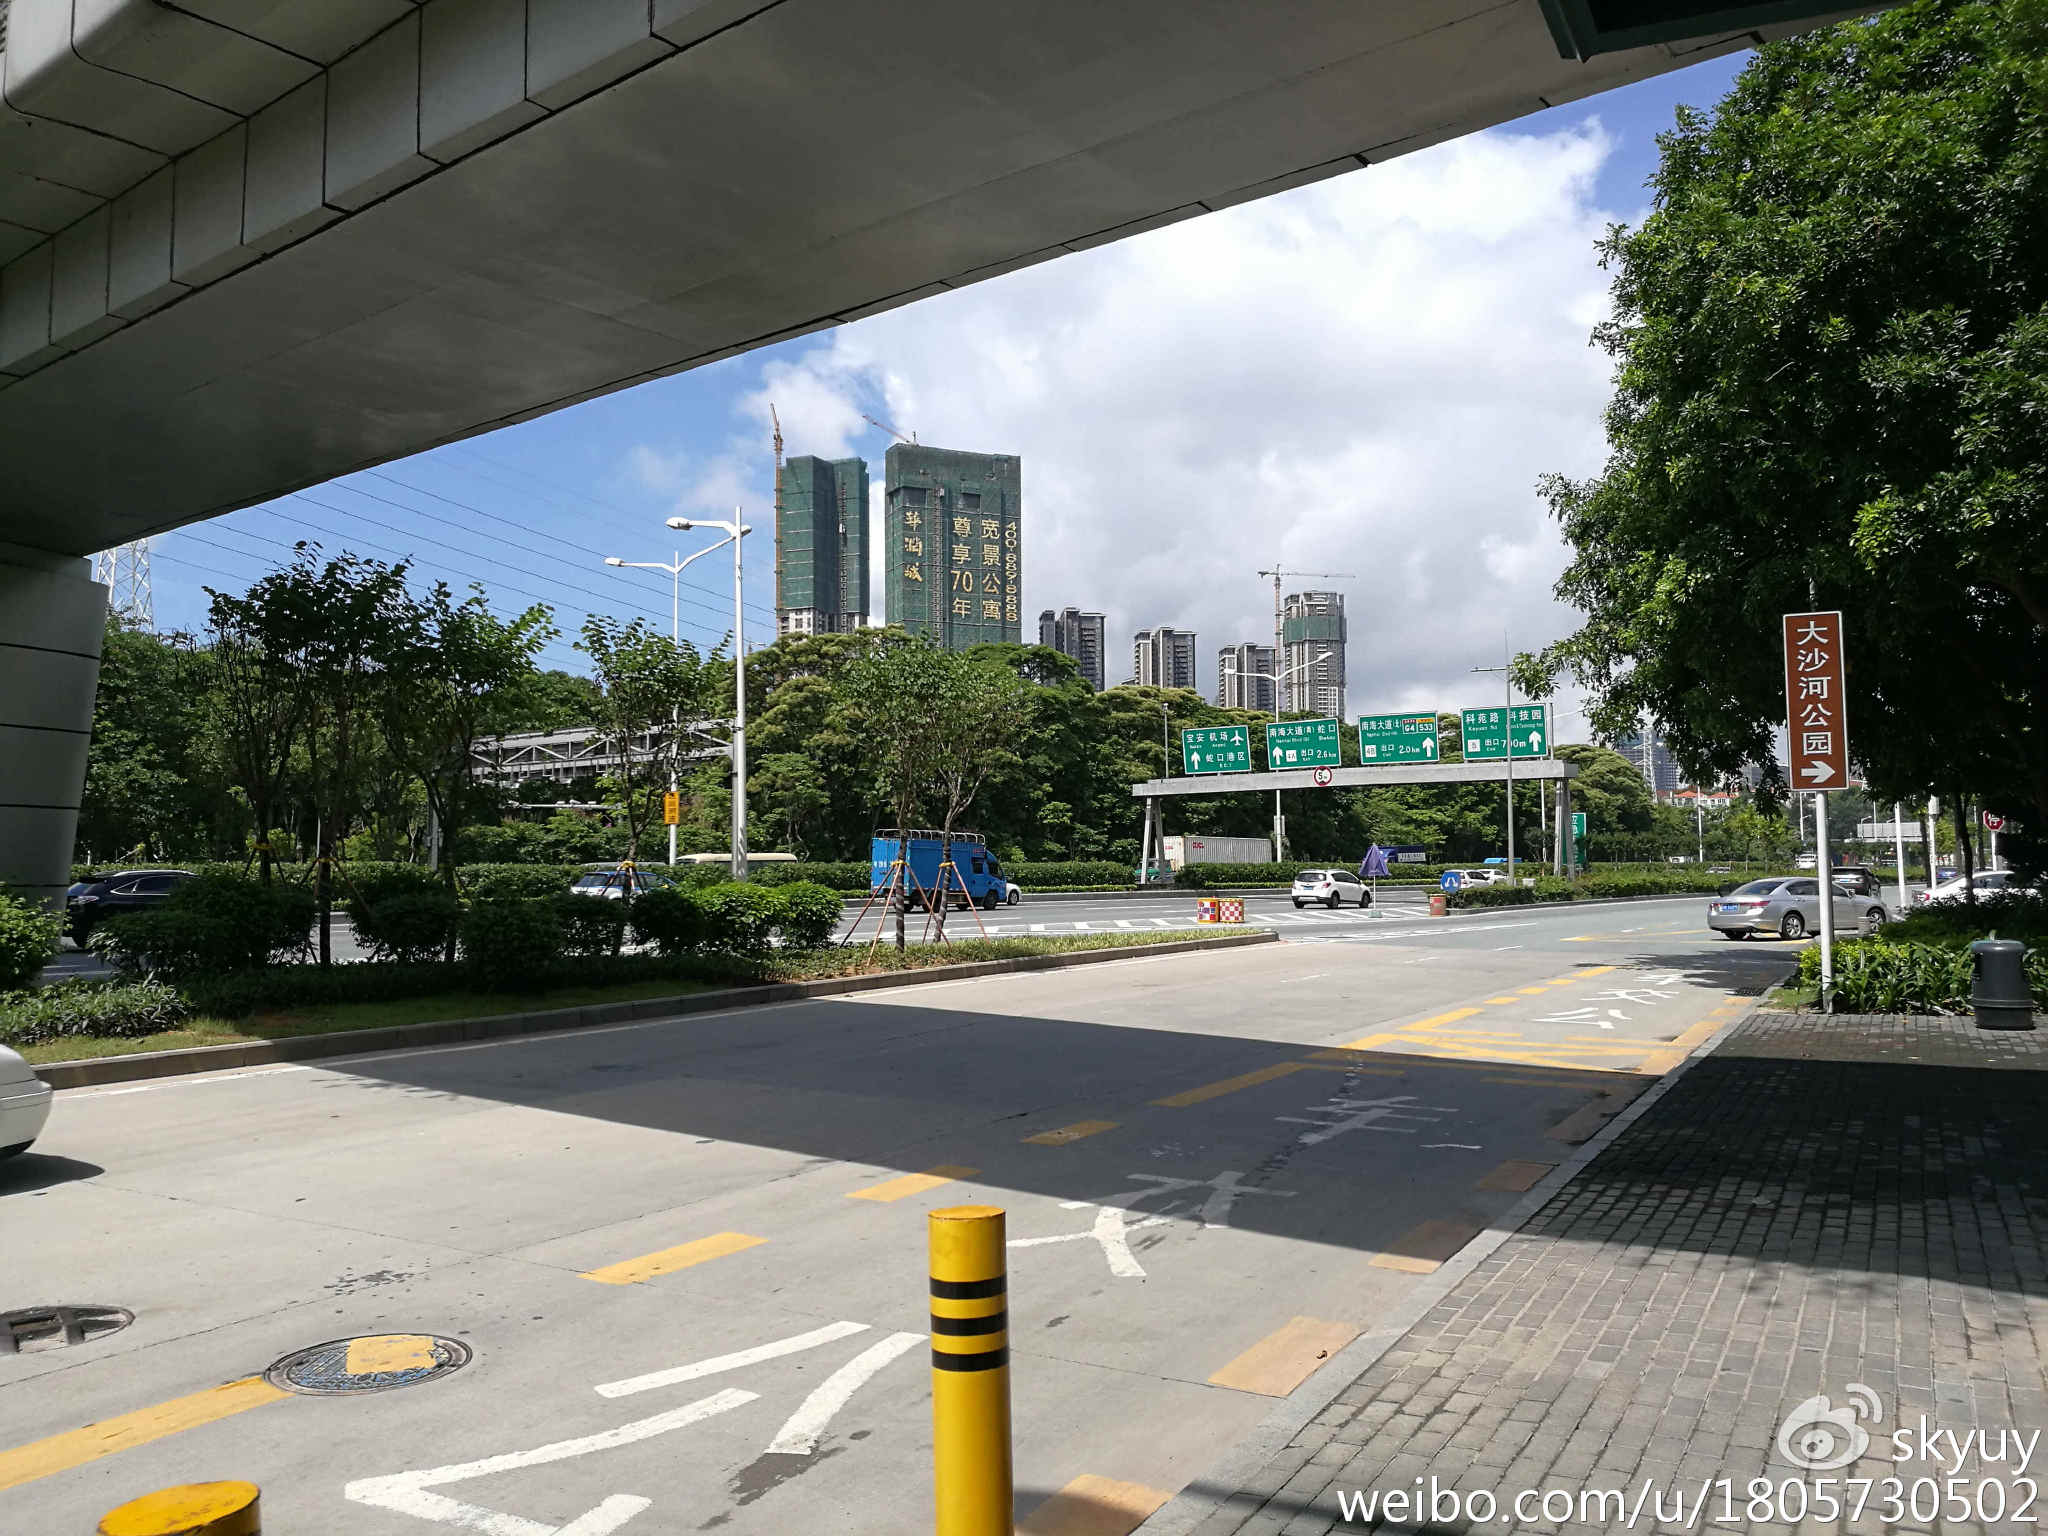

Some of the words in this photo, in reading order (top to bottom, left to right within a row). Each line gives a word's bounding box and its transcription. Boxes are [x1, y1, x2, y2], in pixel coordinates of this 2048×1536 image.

[951, 517, 973, 619] 尊享70年
[981, 519, 1001, 620] 宽景公寓
[1796, 620, 1833, 756] 大沙河公园
[1465, 711, 1499, 724] 科苑路
[1317, 724, 1336, 734] 蛇口
[1404, 724, 1415, 732] G4
[1419, 723, 1433, 731] S33
[1484, 738, 1500, 746] 出口
[1501, 739, 1526, 749] 70m
[1206, 751, 1246, 763] 蛇口港区
[1301, 748, 1314, 757] 出口
